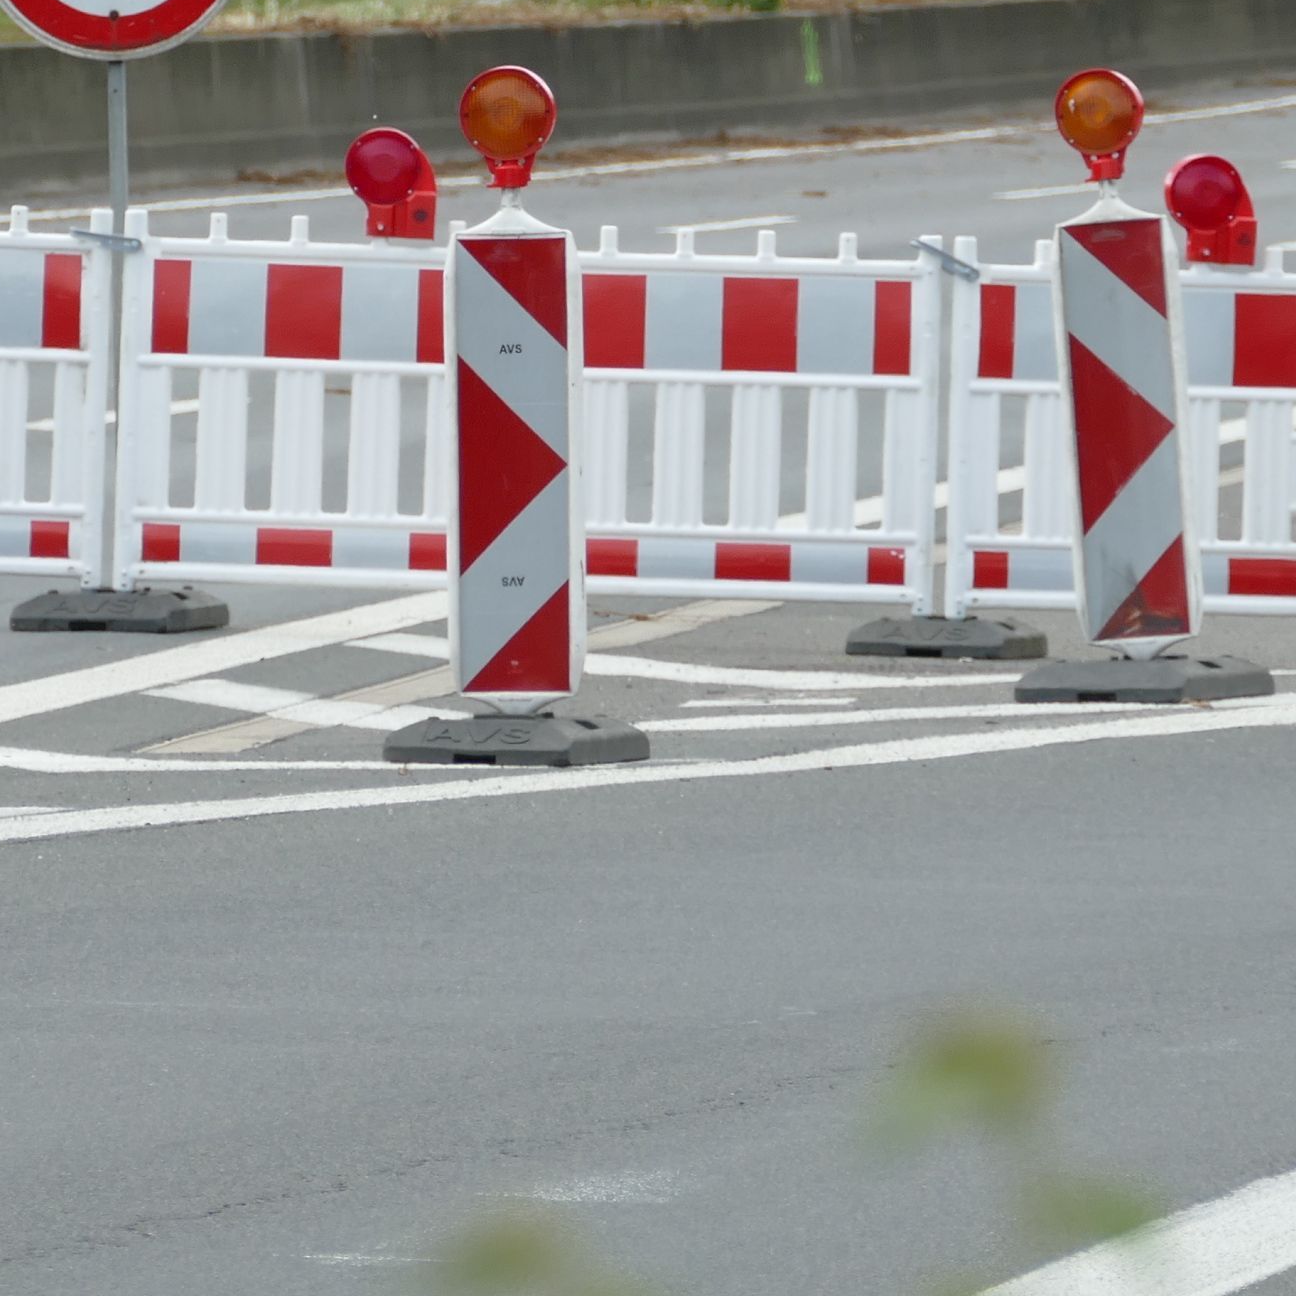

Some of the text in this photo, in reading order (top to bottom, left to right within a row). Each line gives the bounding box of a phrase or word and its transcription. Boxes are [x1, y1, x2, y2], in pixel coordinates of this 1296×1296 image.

[499, 343, 523, 355] AVS
[501, 575, 526, 587] AVS
[44, 597, 140, 616] AVS
[423, 726, 532, 747] AVS
